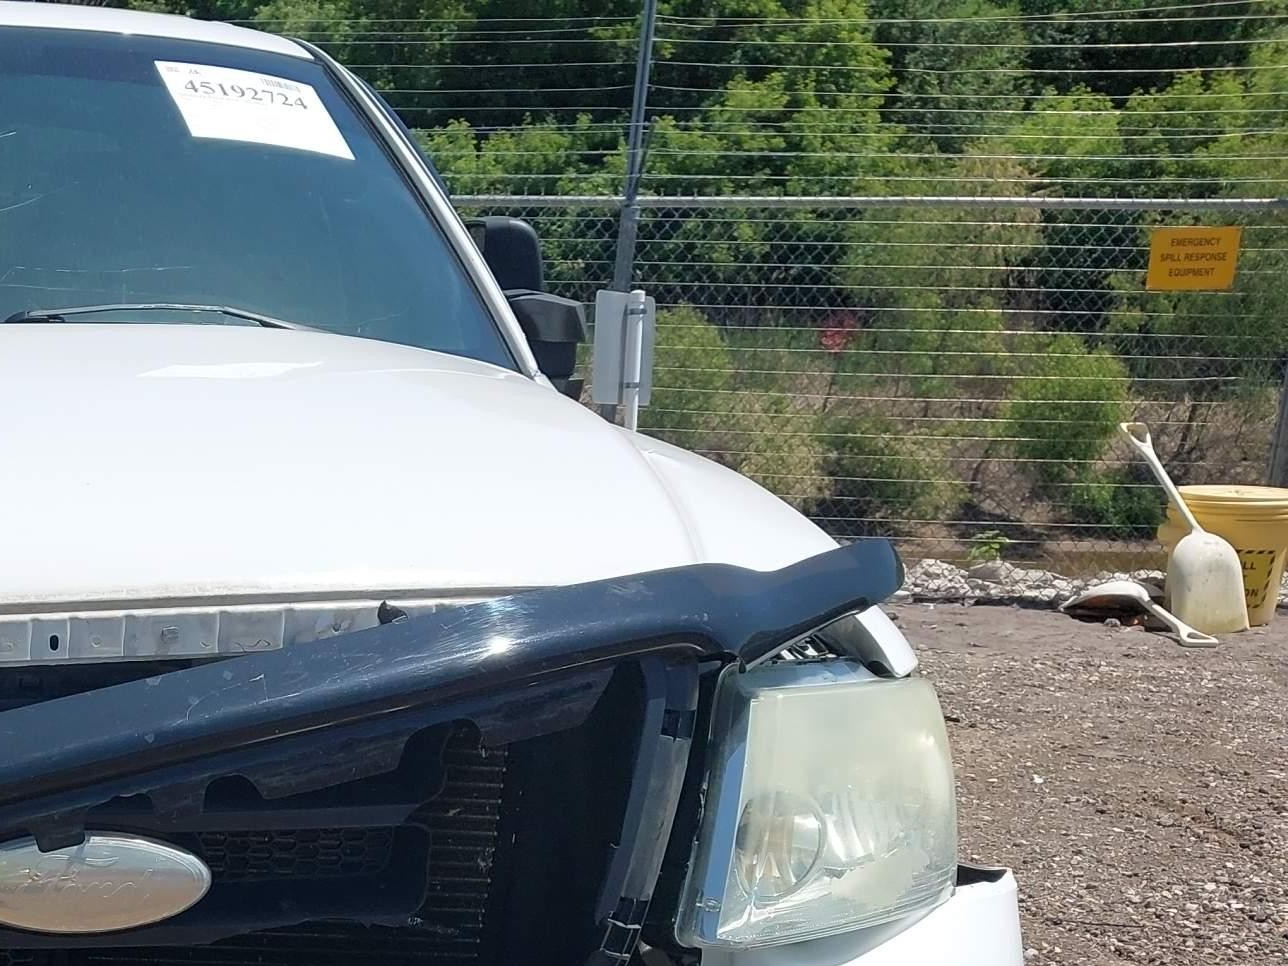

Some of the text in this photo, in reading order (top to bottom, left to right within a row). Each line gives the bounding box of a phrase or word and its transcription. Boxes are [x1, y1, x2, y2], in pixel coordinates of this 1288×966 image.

[184, 79, 307, 109] 45192724
[1171, 237, 1220, 247] EMERGENCY
[1160, 252, 1228, 262] SPILL RESPONSE
[1168, 267, 1215, 276] EQUIPMENT
